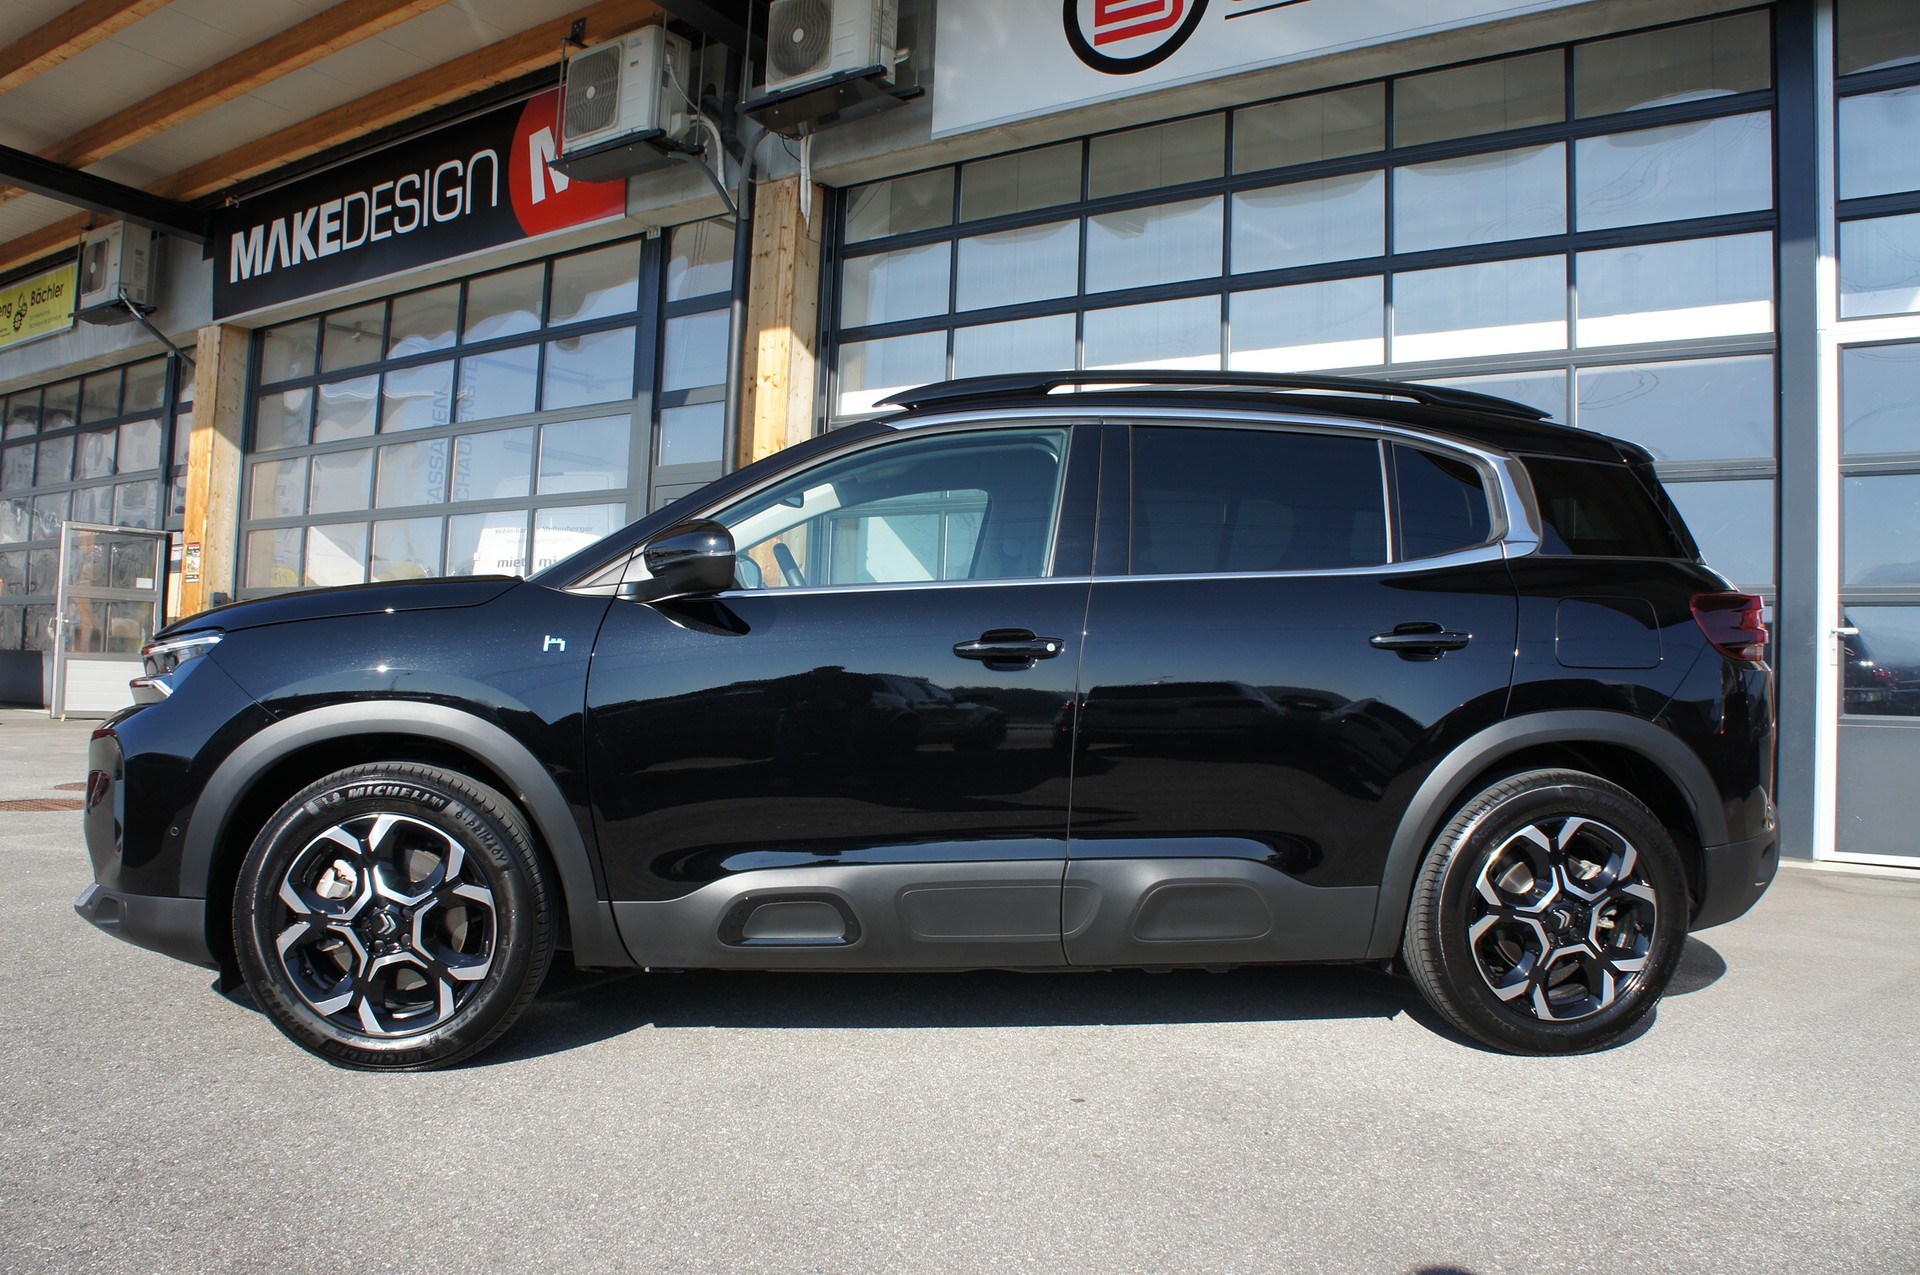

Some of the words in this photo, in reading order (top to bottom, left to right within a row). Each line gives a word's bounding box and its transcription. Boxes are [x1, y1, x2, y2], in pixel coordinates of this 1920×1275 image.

[230, 149, 499, 284] MAKEDESIGN
[31, 283, 64, 306] Bächler
[425, 389, 449, 504] ASSAEN
[347, 785, 446, 808] MICHELIN
